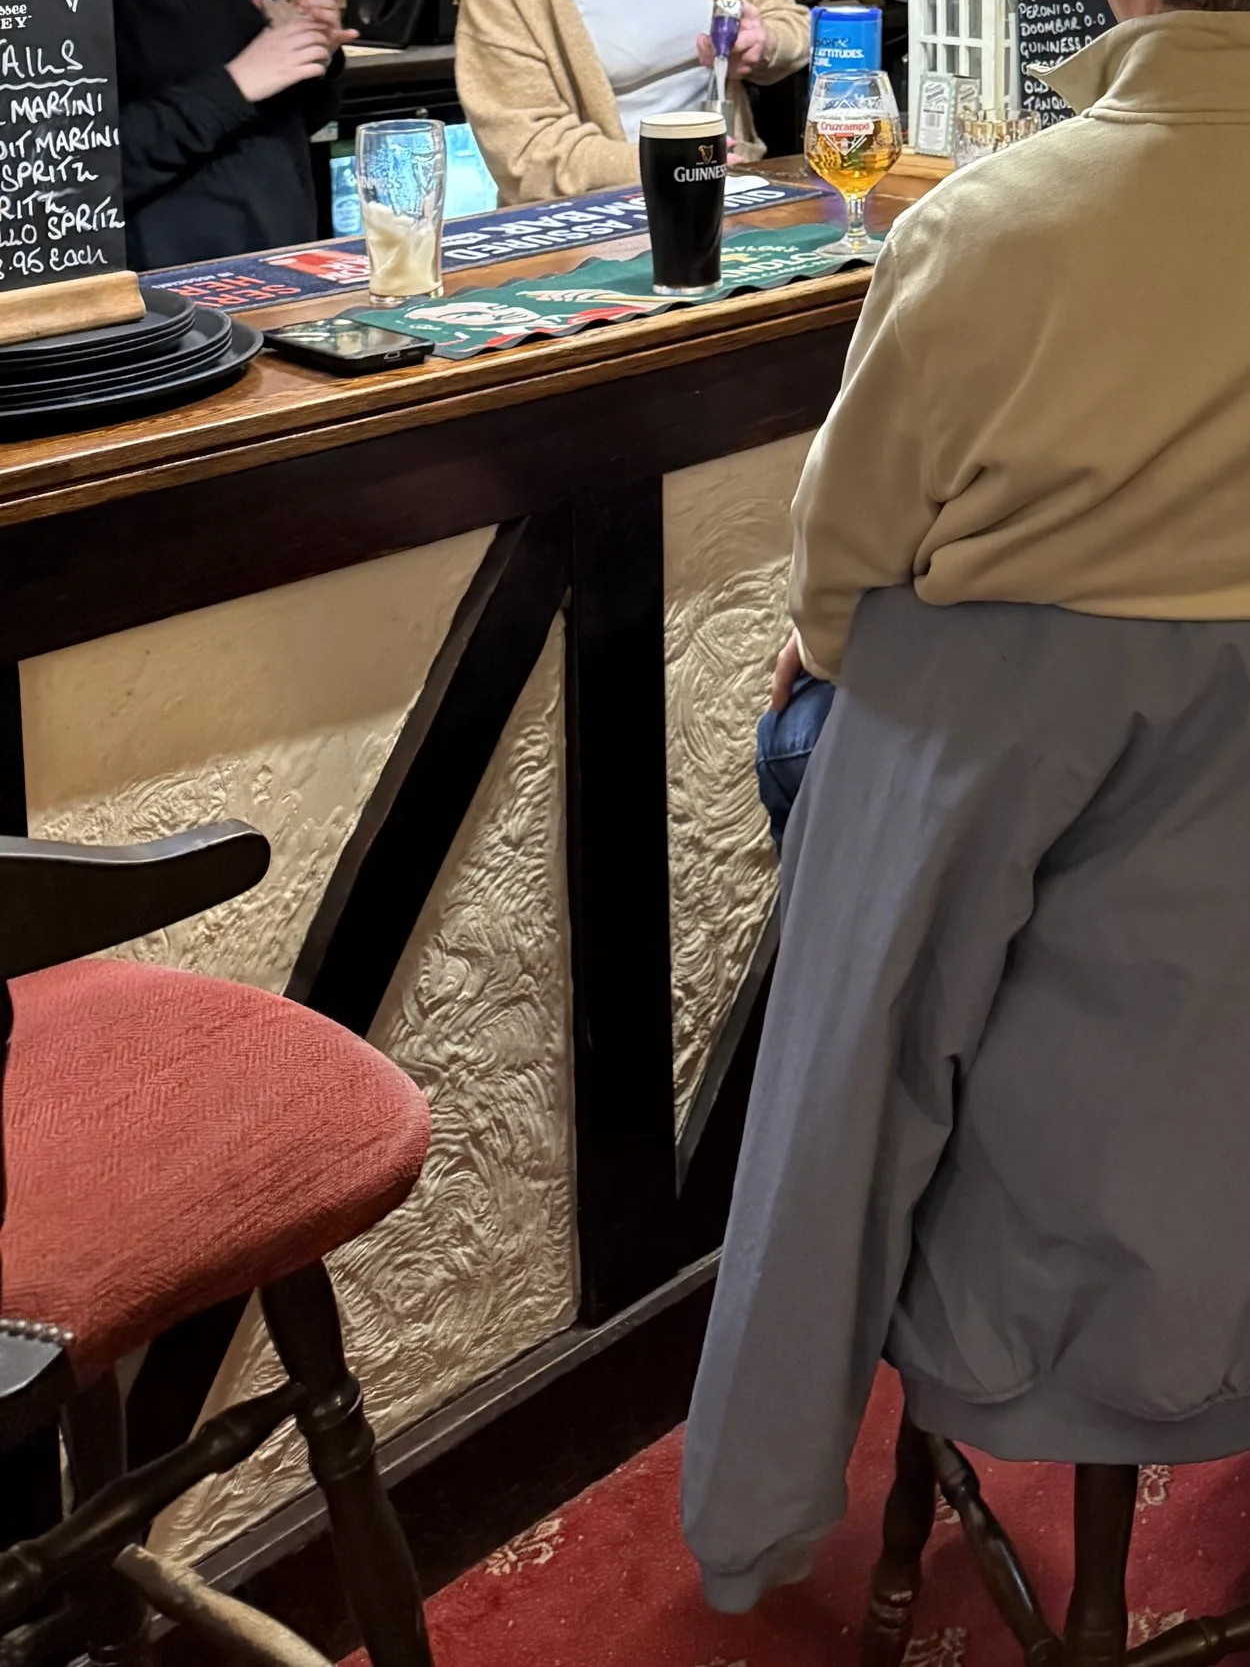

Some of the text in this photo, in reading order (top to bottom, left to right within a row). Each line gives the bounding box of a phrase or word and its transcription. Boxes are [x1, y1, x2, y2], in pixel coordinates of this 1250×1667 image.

[1018, 1, 1085, 20] PERONI 0.0
[1083, 13, 1106, 28] 0.0
[1019, 37, 1083, 59] GUINNESS
[10, 86, 103, 125] MARTINI
[820, 120, 871, 133] Cruzcampo
[35, 119, 121, 160] MARTINI
